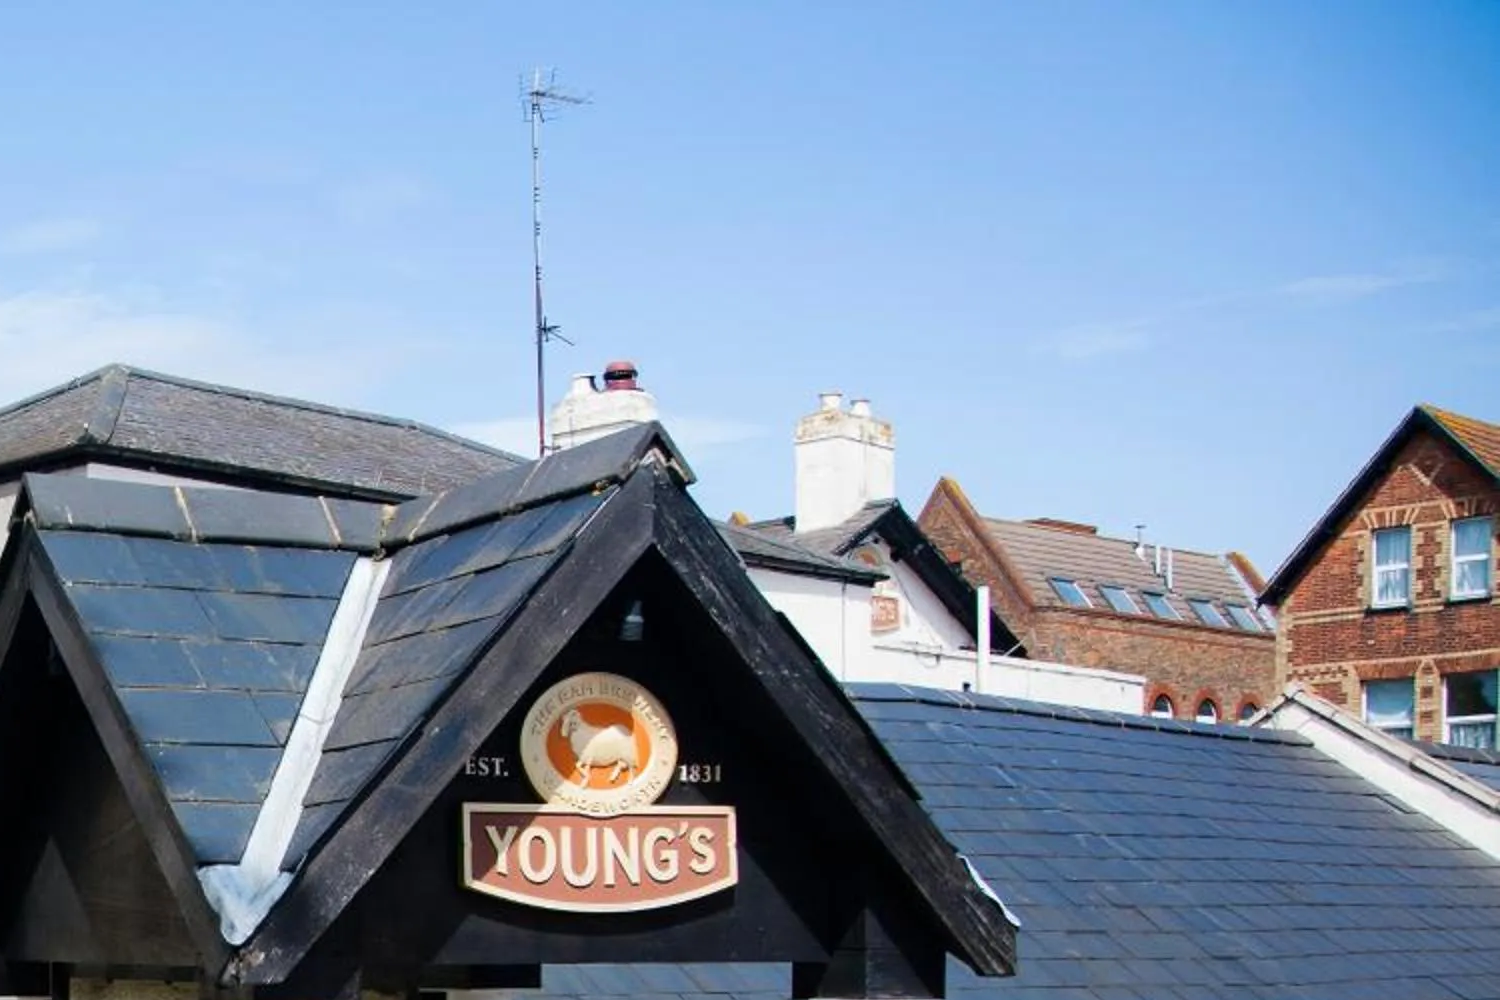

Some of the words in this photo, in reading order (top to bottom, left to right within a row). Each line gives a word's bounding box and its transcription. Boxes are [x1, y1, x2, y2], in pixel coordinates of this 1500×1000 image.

[465, 756, 509, 778] EST.
[678, 764, 722, 783] 1831
[485, 821, 716, 888] YOUNG'S
